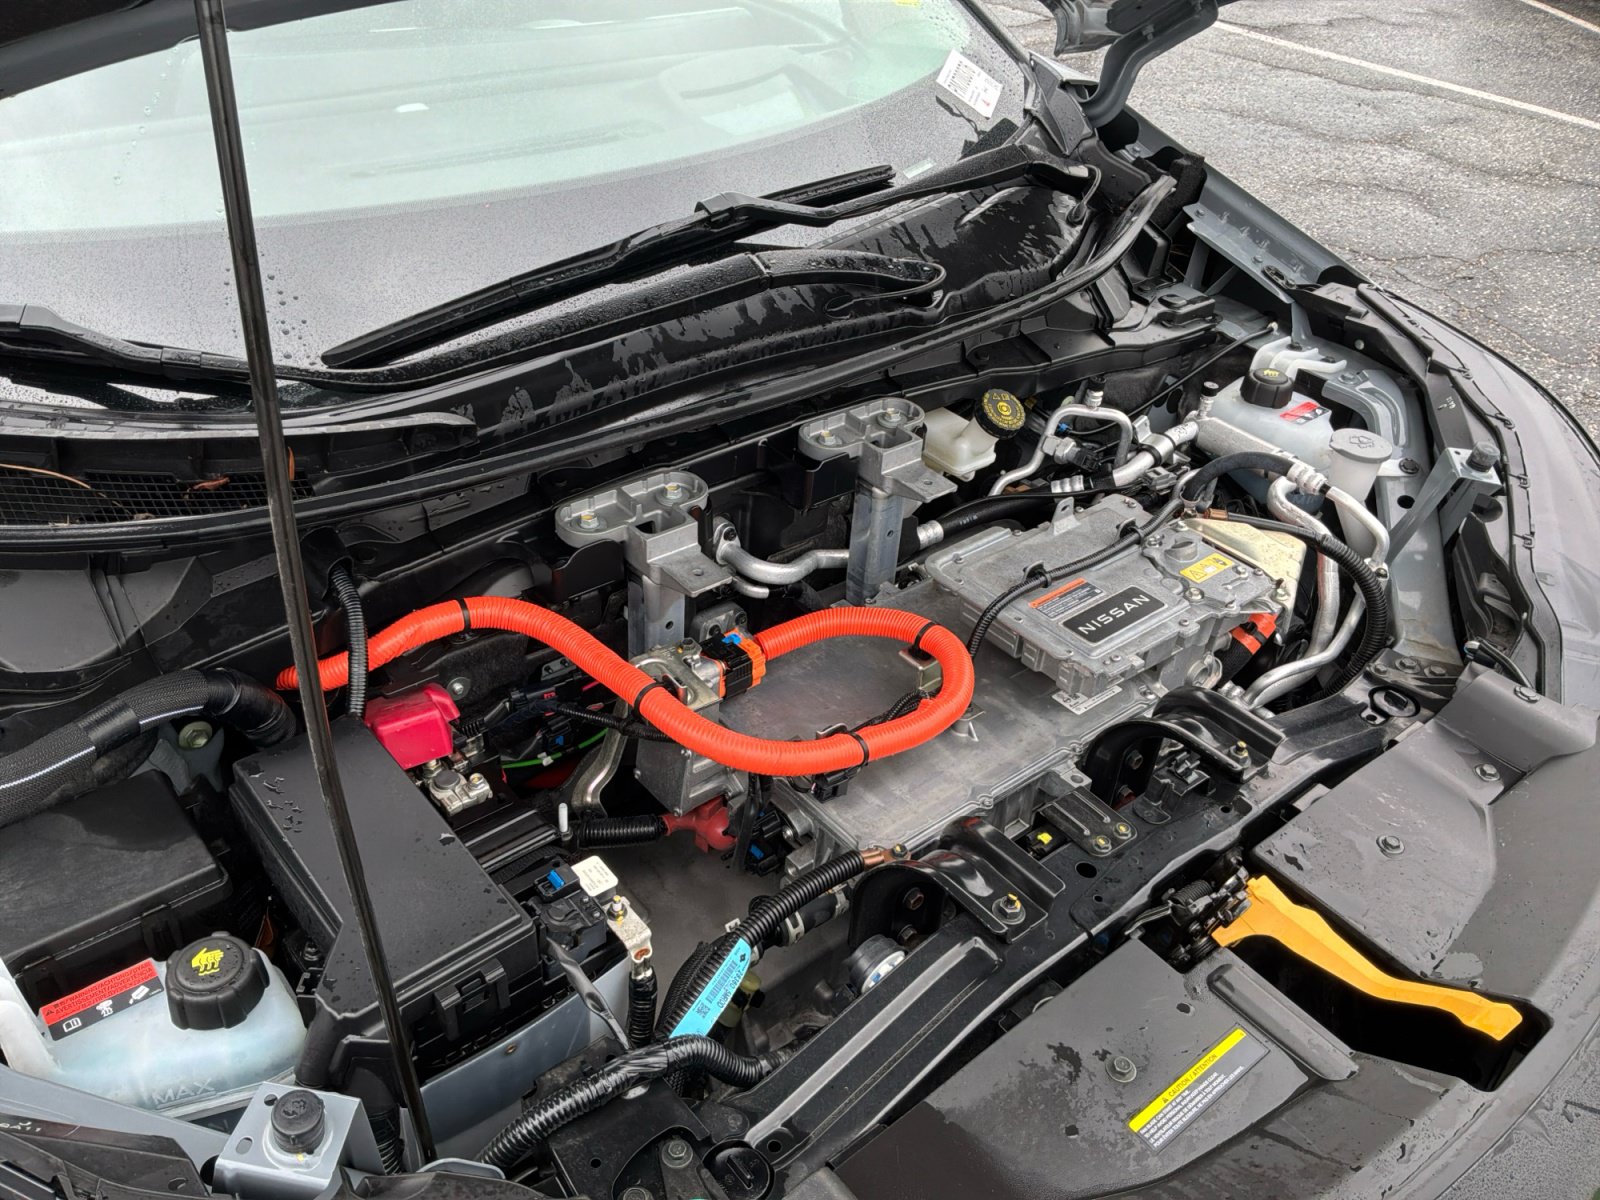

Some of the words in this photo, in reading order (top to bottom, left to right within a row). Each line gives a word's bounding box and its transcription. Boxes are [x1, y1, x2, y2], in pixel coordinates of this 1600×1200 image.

[1078, 595, 1150, 634] NISSAN
[152, 1078, 215, 1105] MAX
[1167, 1076, 1190, 1097] CAUTION
[1191, 1052, 1217, 1076] ATTENTION
